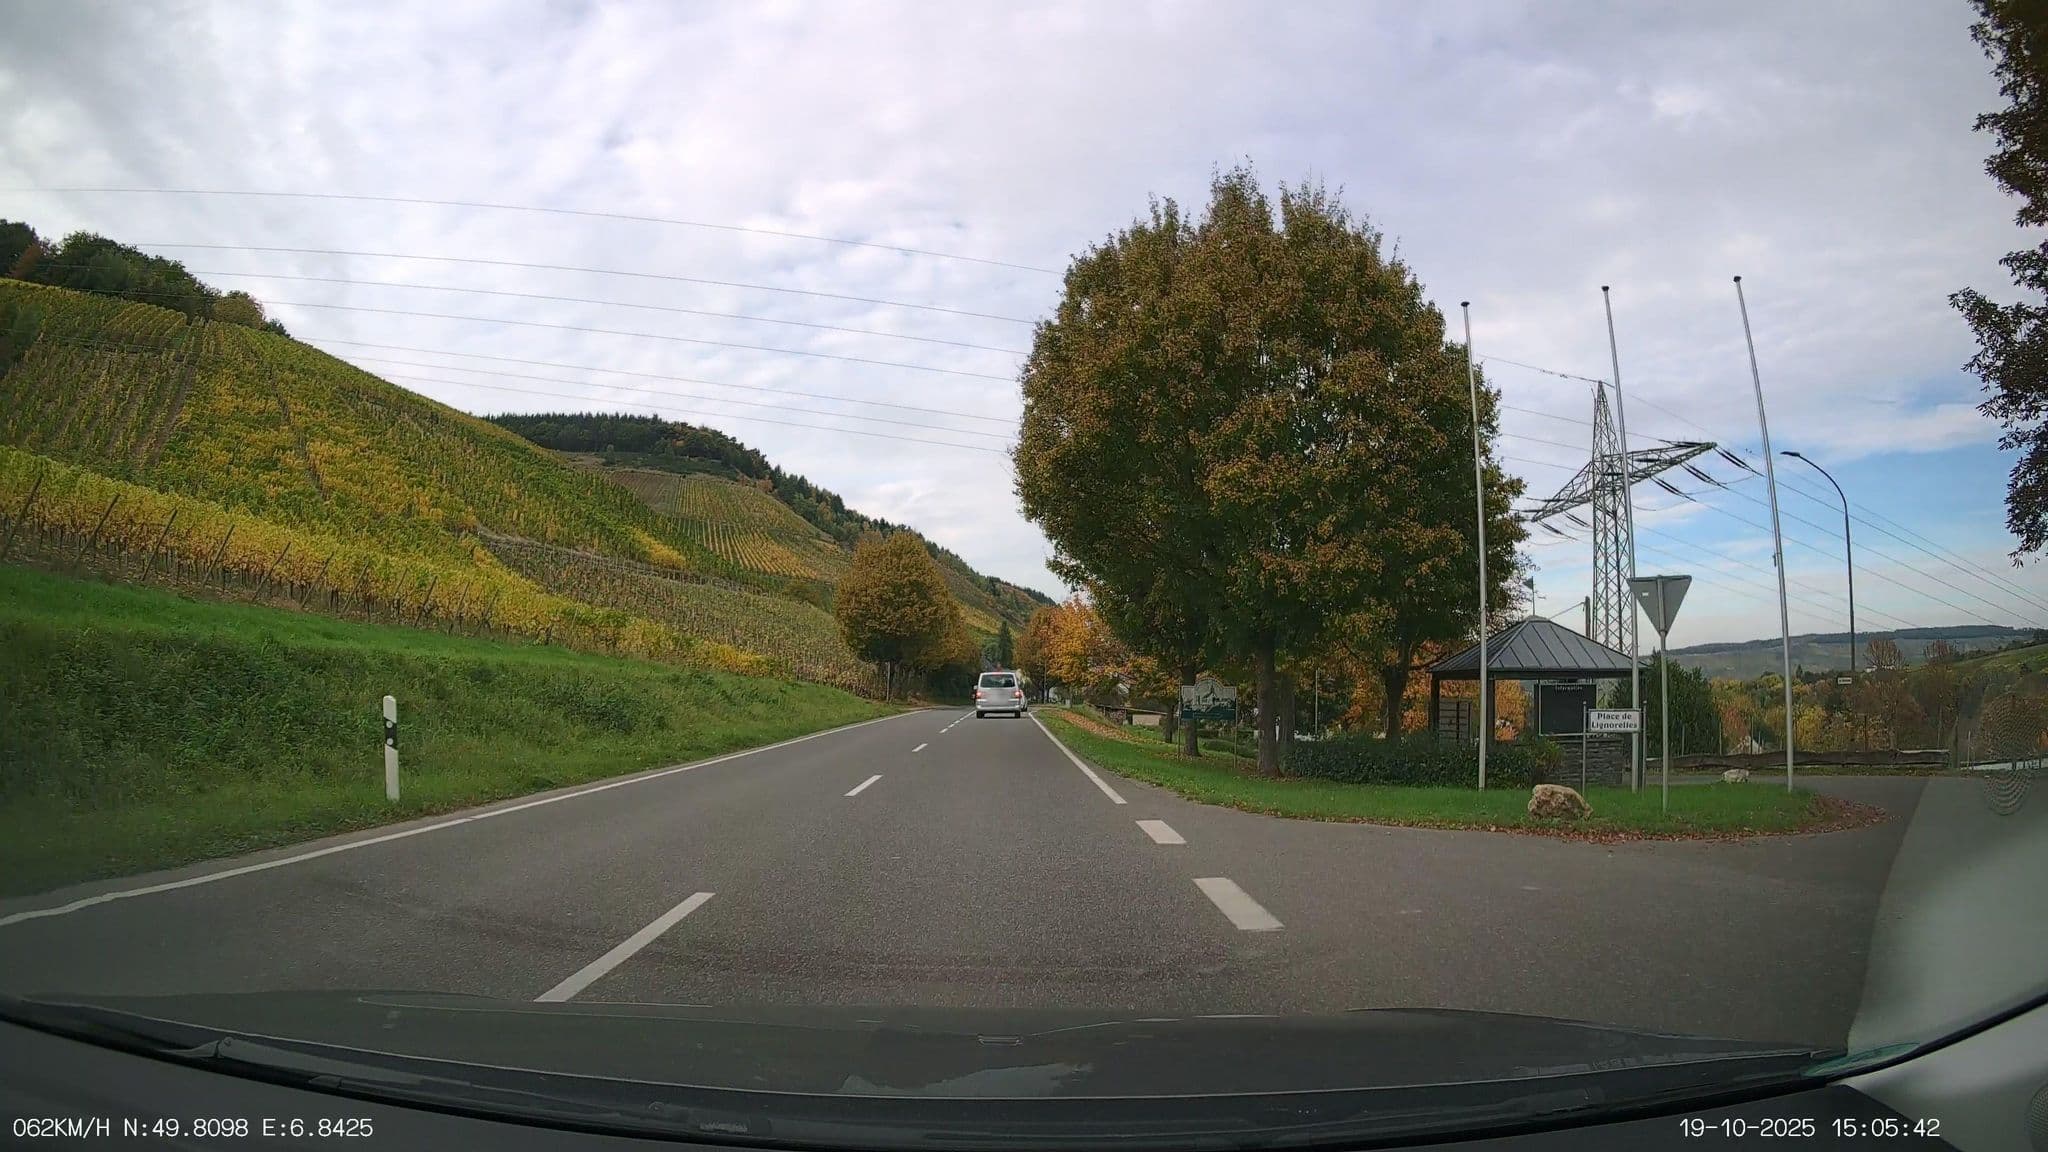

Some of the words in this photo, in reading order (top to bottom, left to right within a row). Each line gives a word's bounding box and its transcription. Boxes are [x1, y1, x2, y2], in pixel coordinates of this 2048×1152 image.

[1597, 712, 1620, 720] Place
[1622, 712, 1632, 720] de
[1591, 721, 1637, 729] Lignorelles
